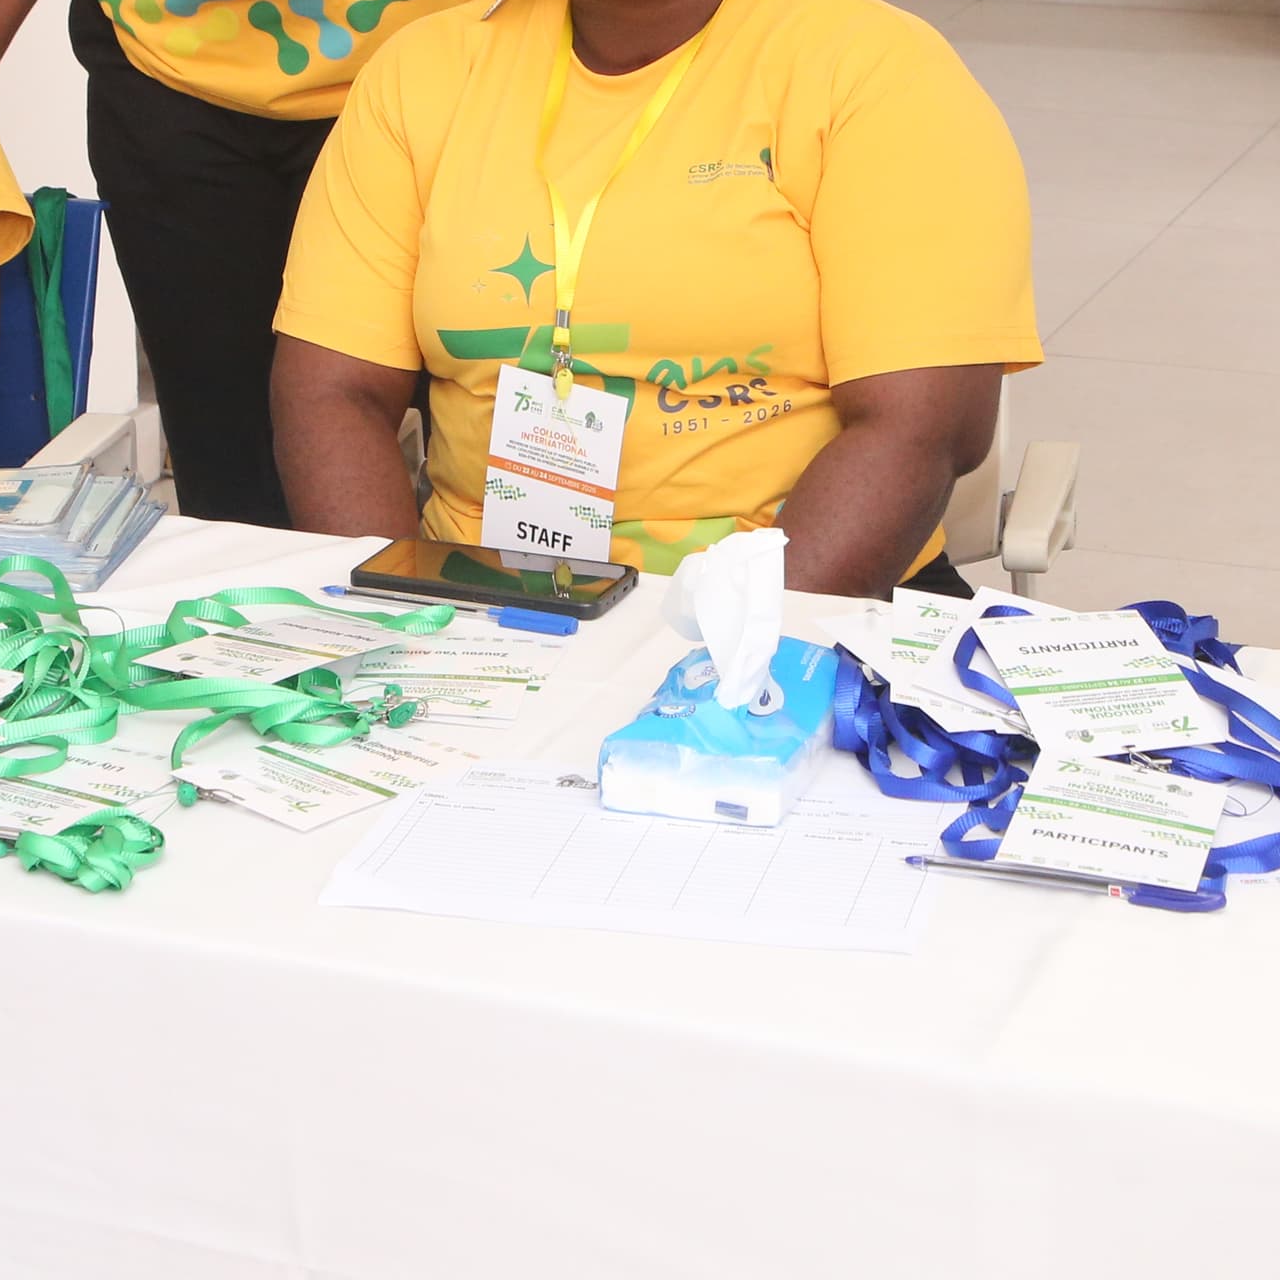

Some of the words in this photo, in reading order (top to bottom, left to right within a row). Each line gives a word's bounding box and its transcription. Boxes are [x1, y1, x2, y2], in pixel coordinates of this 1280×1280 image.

[647, 344, 773, 391] ans
[514, 391, 532, 412] 75
[662, 417, 709, 436] 1951
[743, 400, 793, 424] 2026
[516, 521, 573, 552] STAFF
[1019, 638, 1140, 655] PARTICIPANTS
[1068, 699, 1166, 715] INTERNATIONAL
[1087, 708, 1153, 721] COLLOQUE
[1171, 716, 1199, 732] 75
[1056, 760, 1084, 774] 75
[1032, 828, 1169, 859] PARTICIPANTS
